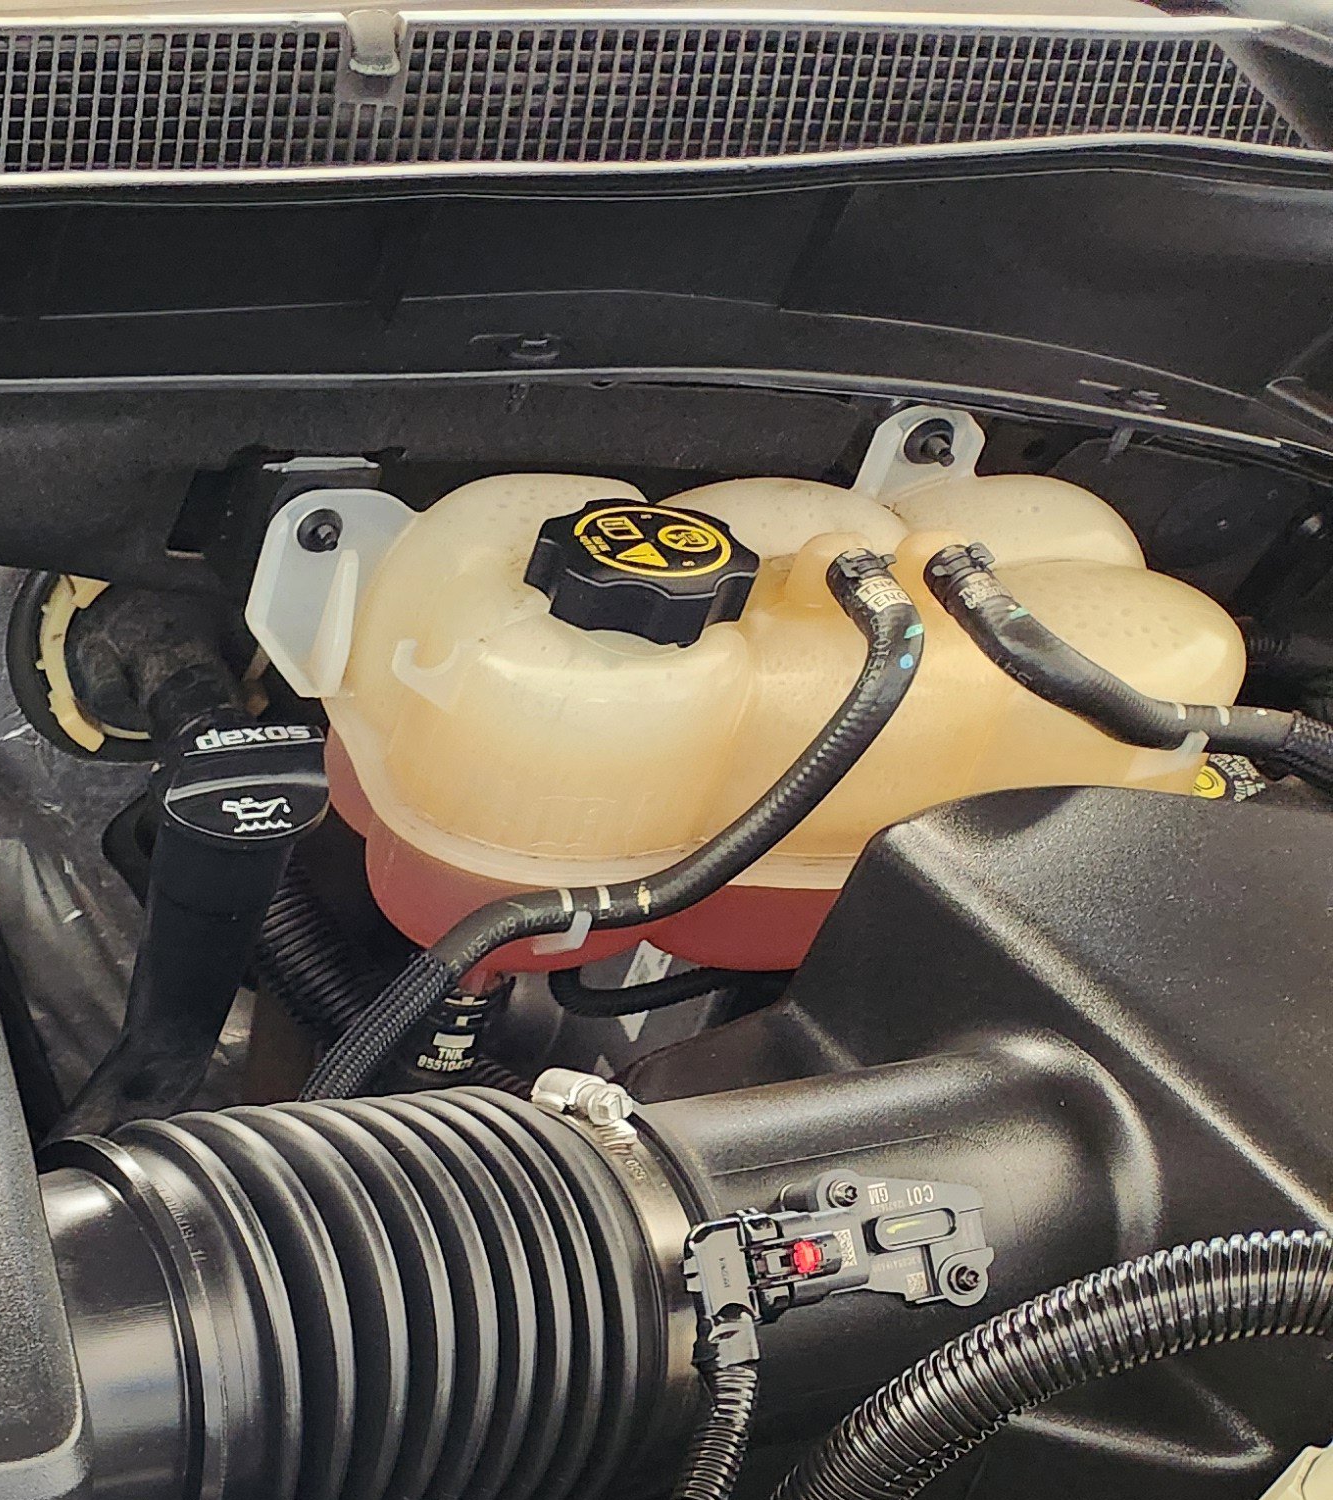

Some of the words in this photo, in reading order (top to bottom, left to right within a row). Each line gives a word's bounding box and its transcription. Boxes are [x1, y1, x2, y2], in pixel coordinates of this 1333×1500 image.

[873, 591, 909, 607] ENG
[195, 725, 311, 751] dexos
[868, 1183, 889, 1205] GM
[907, 1185, 934, 1206] C01
